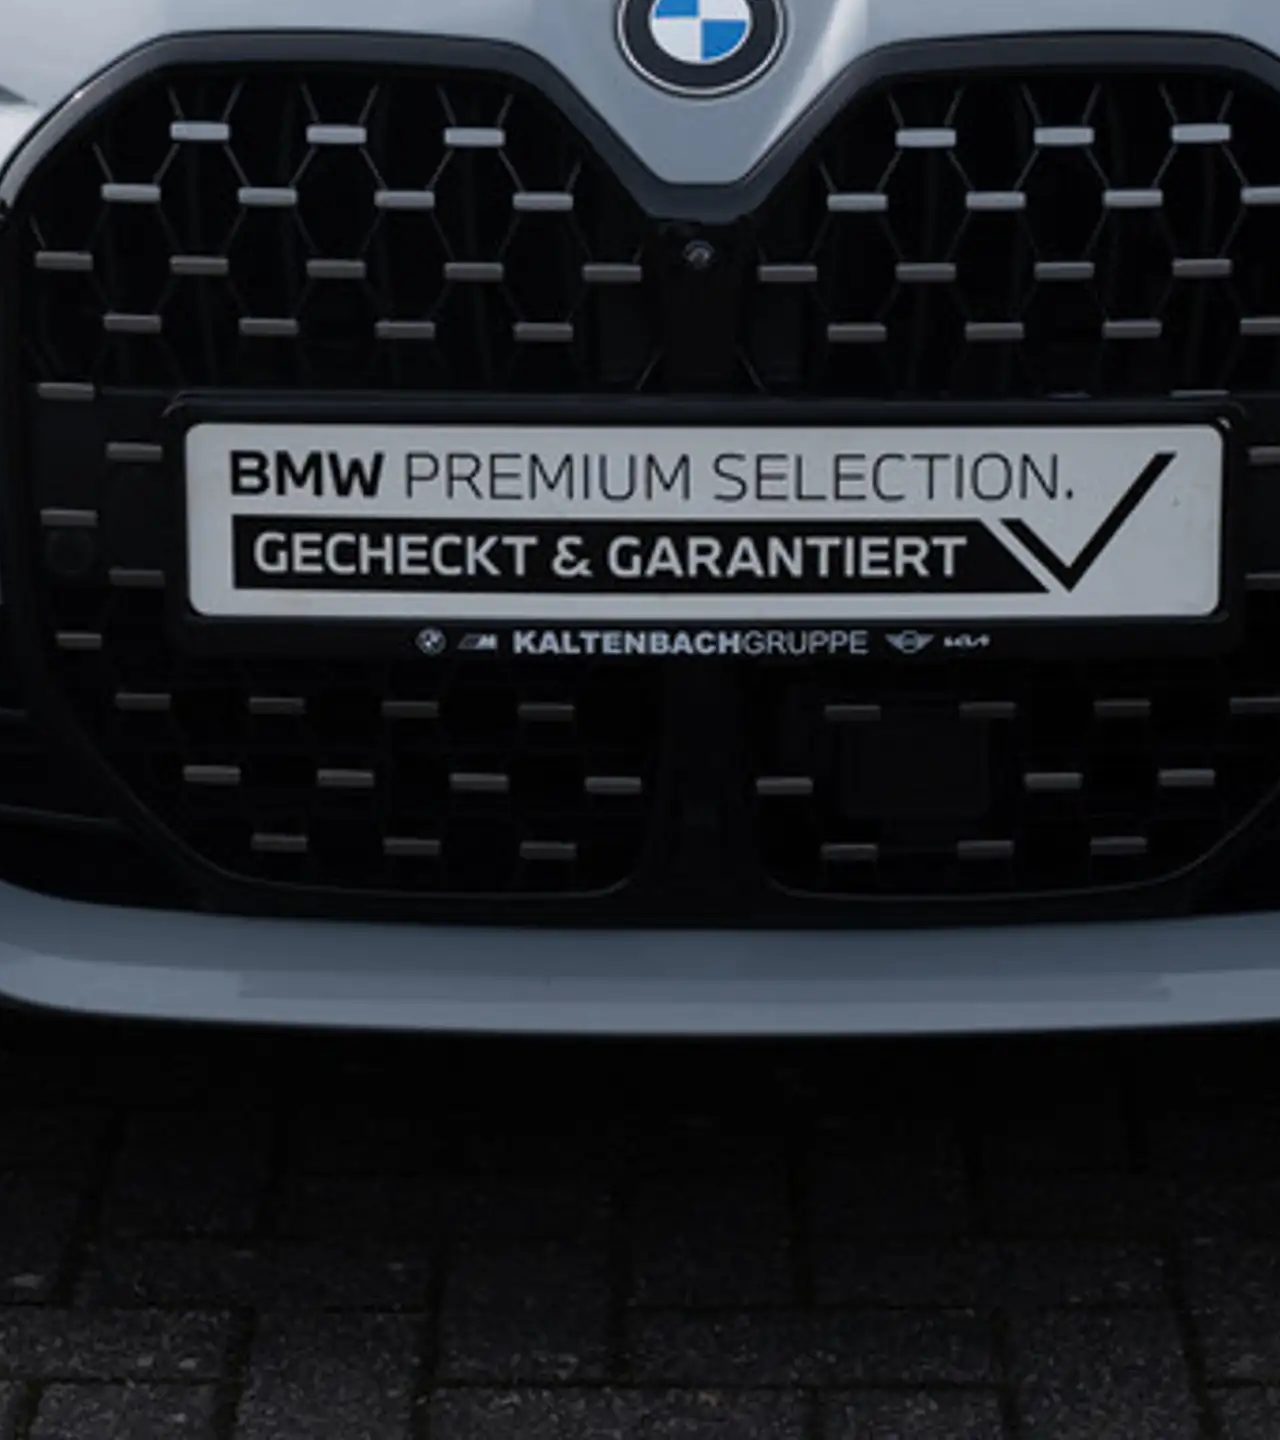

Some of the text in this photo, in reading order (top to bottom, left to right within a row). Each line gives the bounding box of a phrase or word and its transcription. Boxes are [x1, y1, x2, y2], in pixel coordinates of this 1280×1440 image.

[229, 450, 1075, 503] BMW PREMIUM SELECTION.
[252, 531, 968, 578] GECHECKT & GARANTIERT
[512, 629, 870, 656] KALTENBACHGRUPPE
